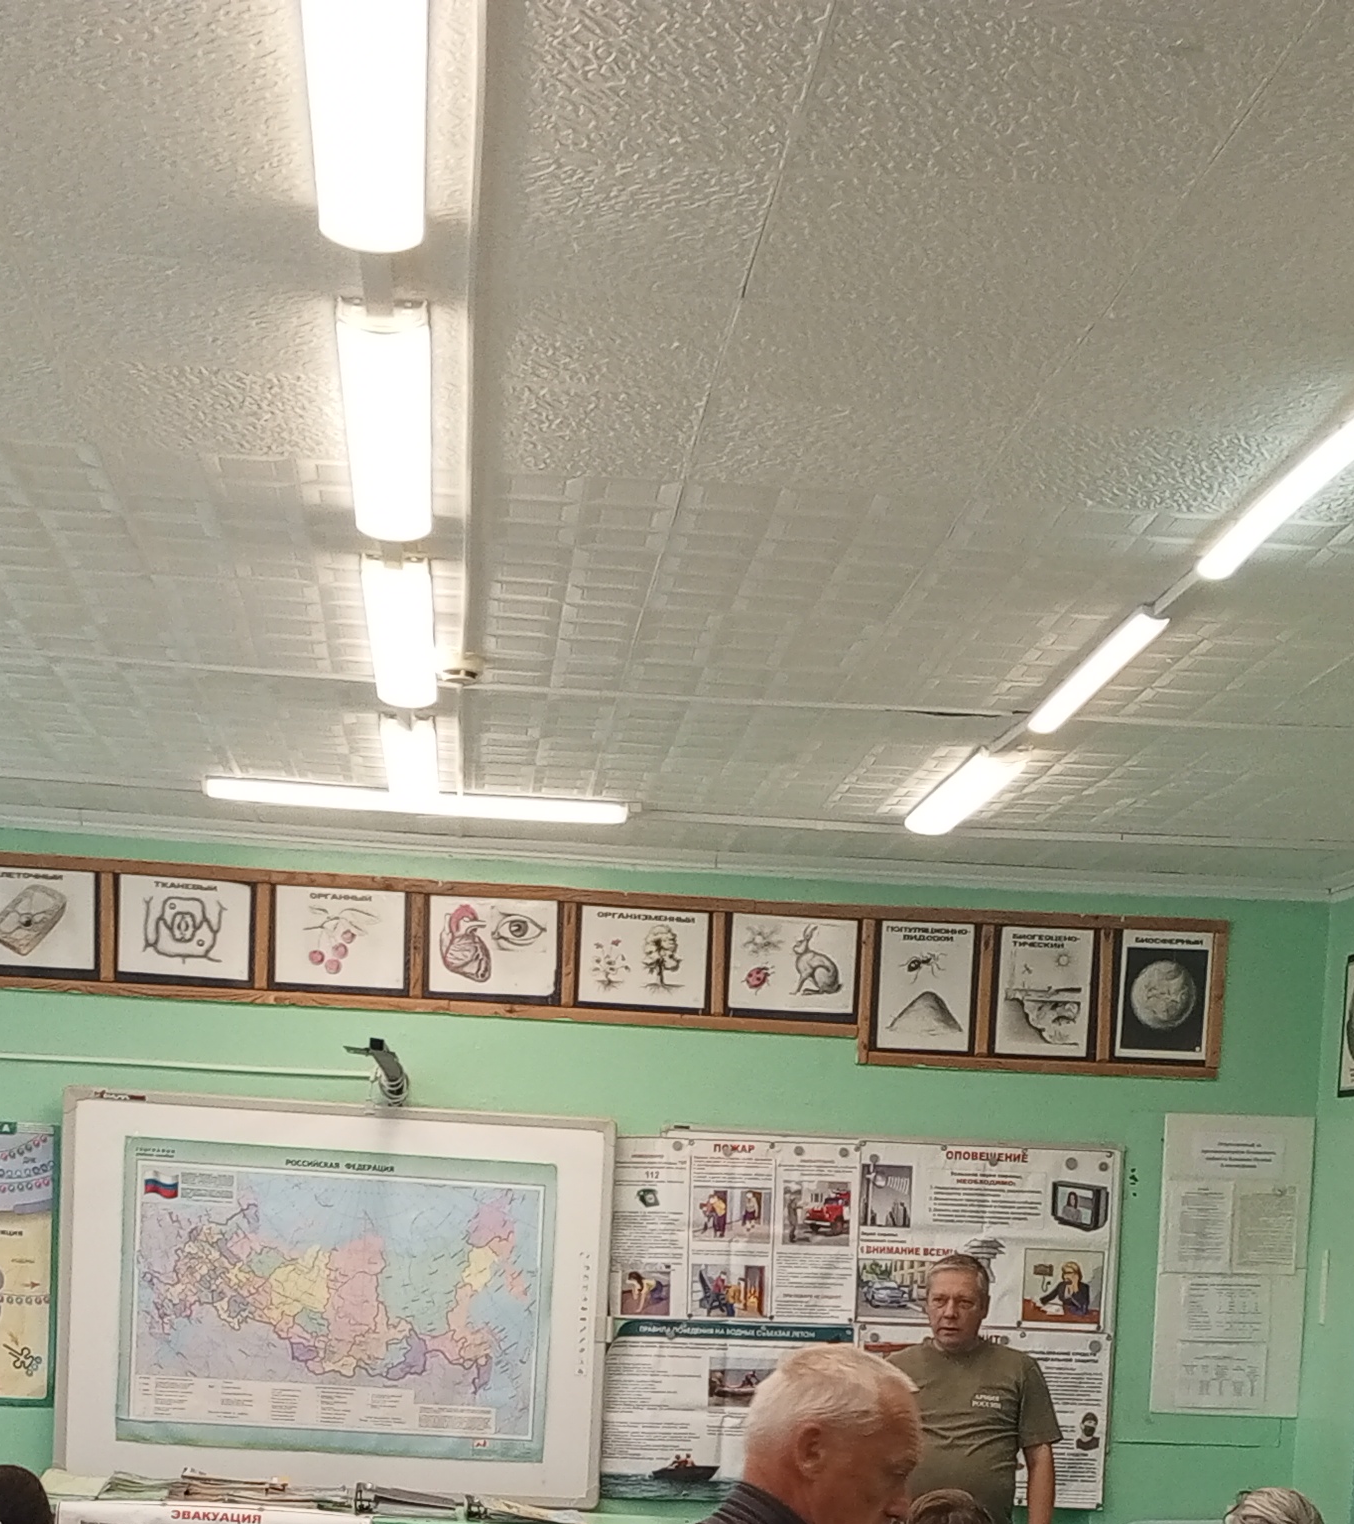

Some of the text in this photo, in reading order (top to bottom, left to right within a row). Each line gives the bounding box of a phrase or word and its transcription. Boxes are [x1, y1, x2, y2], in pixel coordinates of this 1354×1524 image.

[154, 880, 218, 892] ТКАНЕВЫЙ
[309, 891, 373, 902] ОРГАННЫЙ
[596, 911, 696, 924] ОРГАНИЗМЕННЫЙ
[1012, 940, 1065, 949] ТИЧЕСКИЙ
[1134, 936, 1204, 946] БИОСФЕРНЫЙ
[713, 1143, 756, 1154] ПОЖАР
[946, 1150, 1029, 1163] ОПОВЕЩЕНИЕ
[285, 1158, 395, 1173] РОССИЙСКАЯ ФЕДЕРАЦИЯ
[645, 1169, 660, 1179] 112
[170, 1509, 262, 1524] ЭВАКУАЦИЯ
